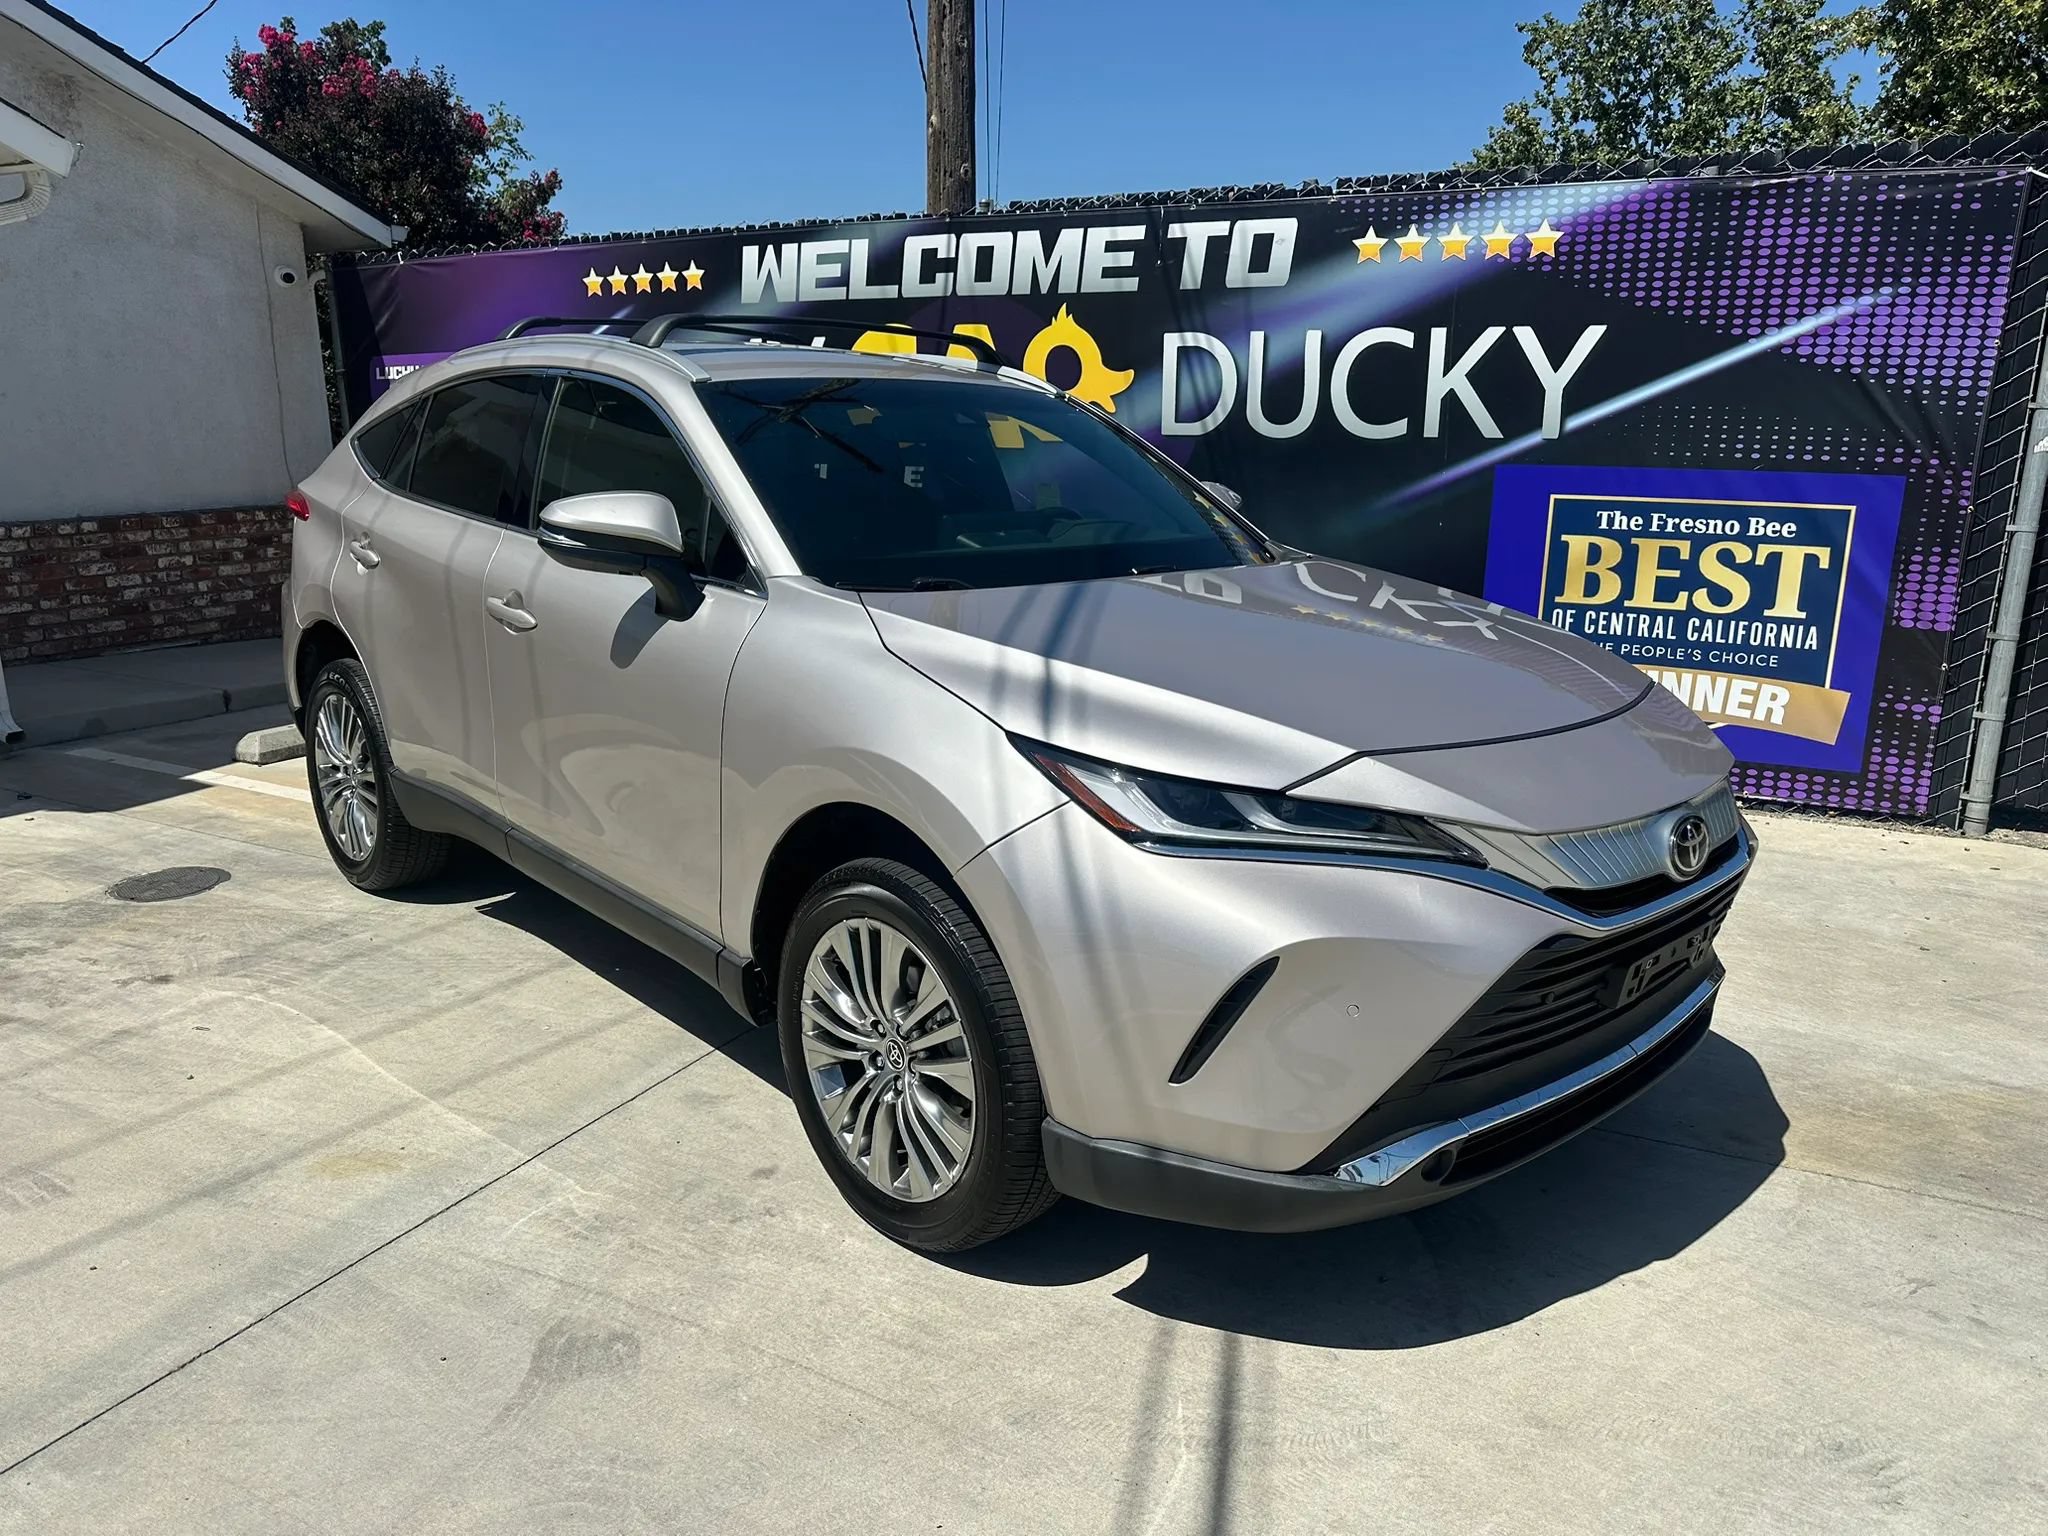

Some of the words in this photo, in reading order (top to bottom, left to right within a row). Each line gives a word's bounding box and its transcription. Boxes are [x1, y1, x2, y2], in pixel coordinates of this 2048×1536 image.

[741, 223, 1147, 304] WELCOME
[1166, 217, 1299, 290] TO
[1159, 323, 1608, 440] DUCKY
[1597, 510, 1643, 532] The
[1649, 512, 1740, 537] Fresno
[1746, 516, 1797, 538] Bee
[1554, 534, 1831, 619] BEST
[1552, 608, 1576, 632] OF
[1584, 609, 1677, 640] CENTRAL
[1686, 616, 1818, 650] CALIFORNIA
[1708, 650, 1779, 668] CHOICE
[1641, 669, 1791, 726] NNER
